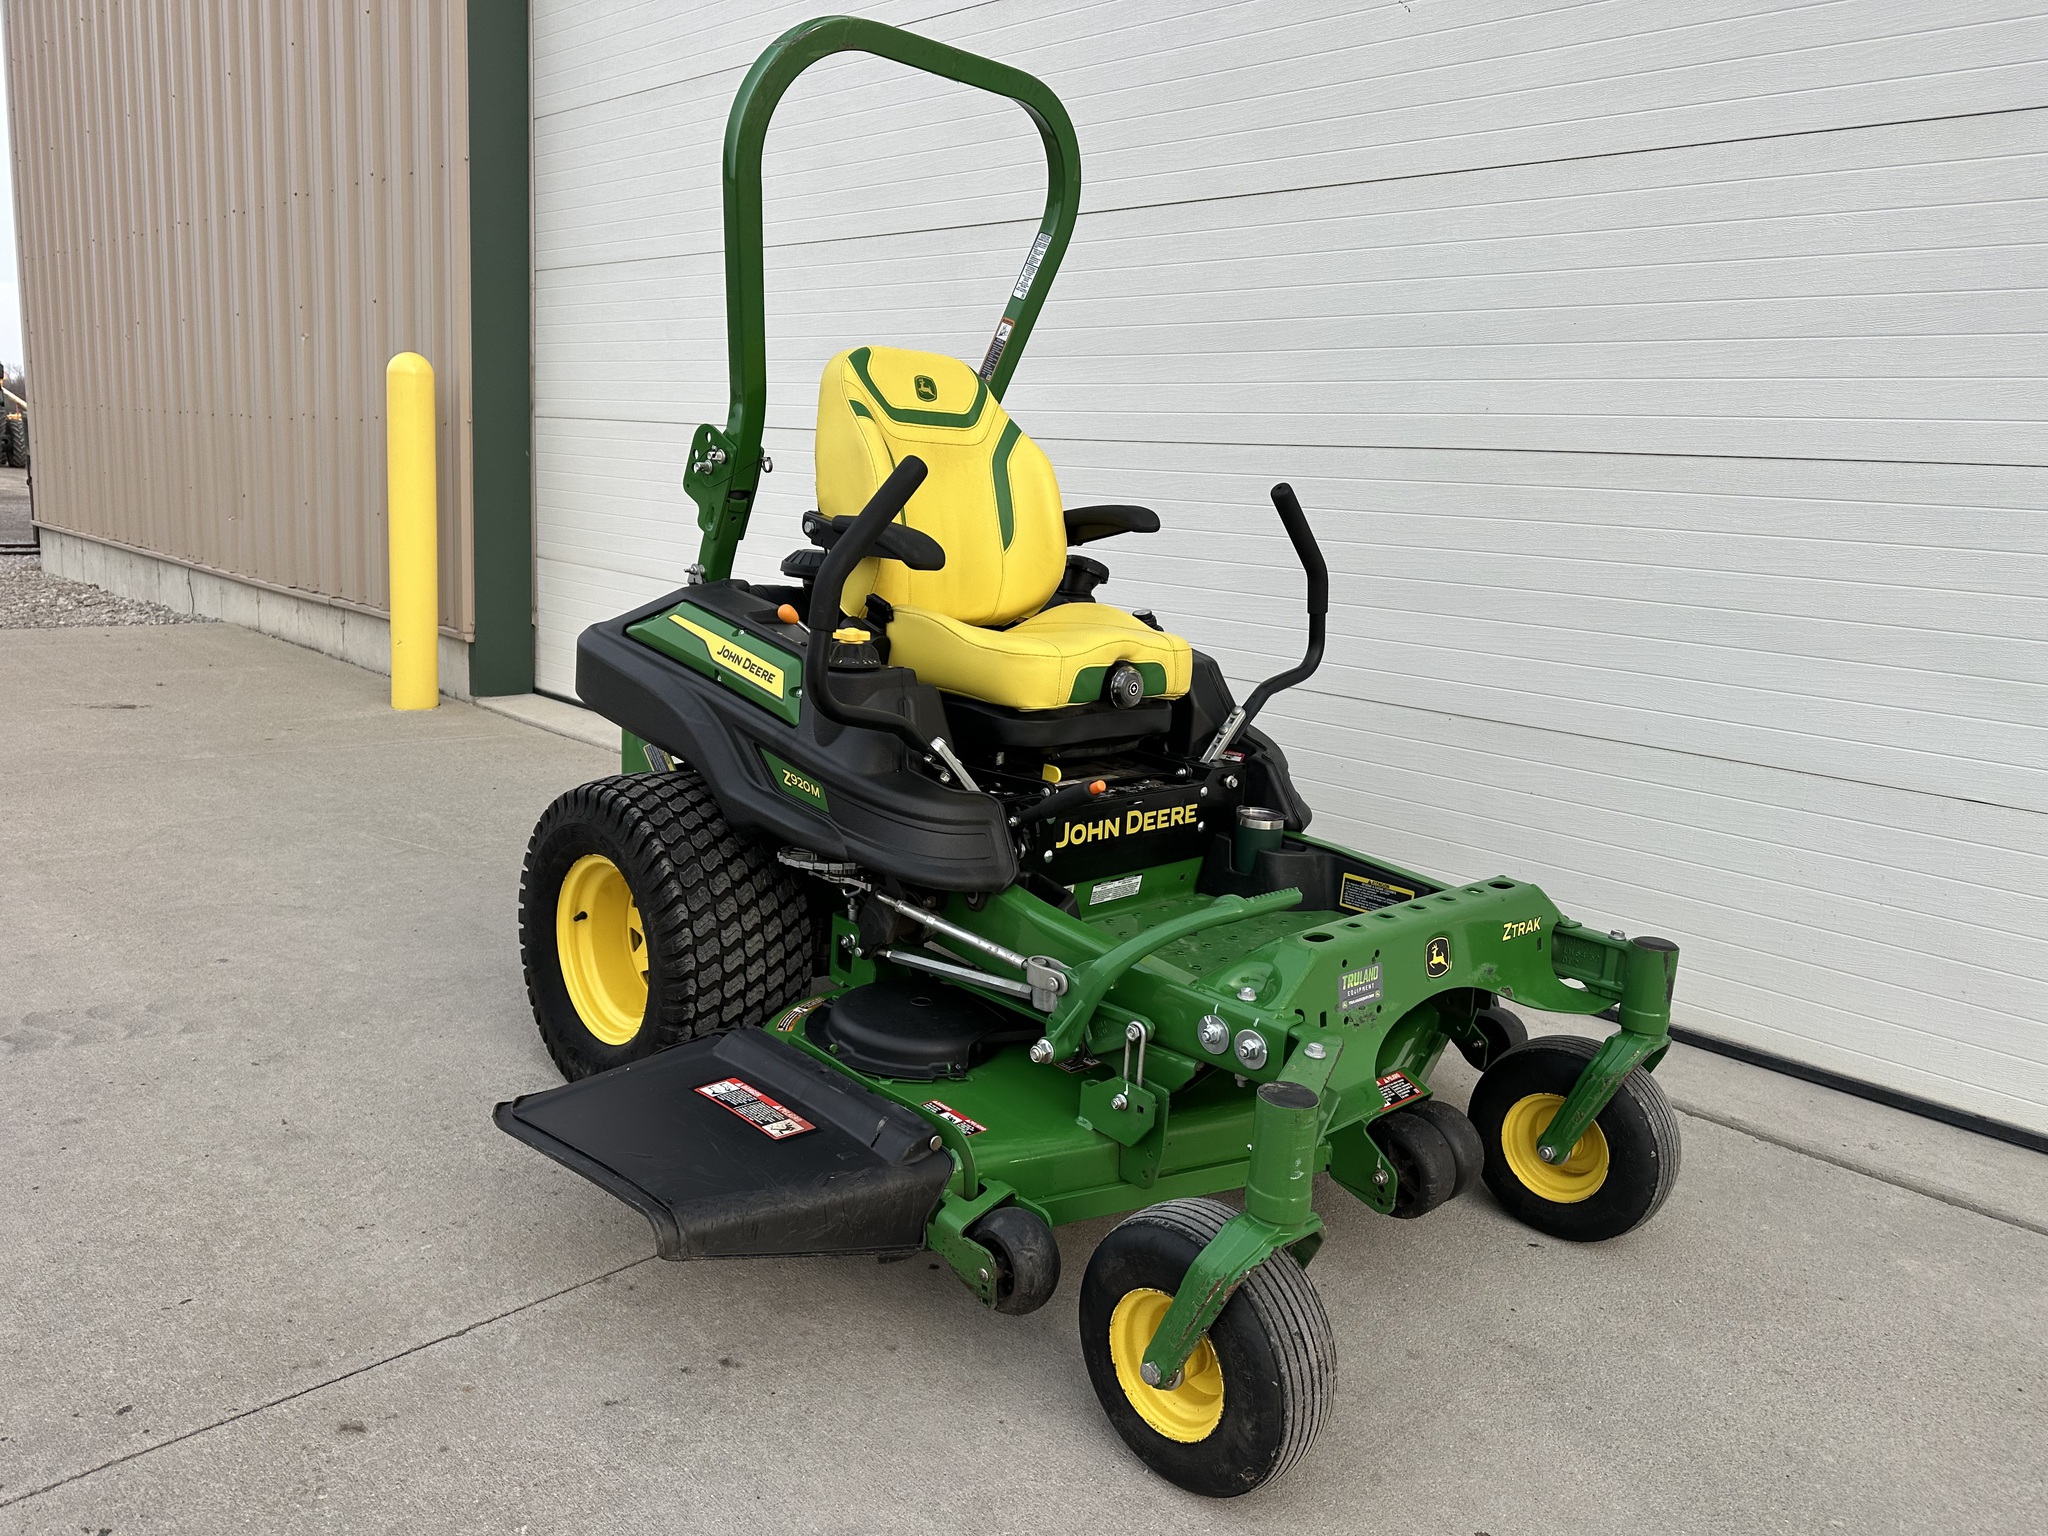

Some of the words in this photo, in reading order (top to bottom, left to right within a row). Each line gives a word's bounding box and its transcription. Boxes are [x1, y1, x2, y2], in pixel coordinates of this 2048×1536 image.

[717, 645, 743, 666] JOHN
[742, 658, 776, 684] DEERE
[782, 768, 821, 799] Z920M
[1055, 817, 1121, 849] JOHN
[1126, 804, 1198, 835] DEERE
[1502, 916, 1542, 942] ZTRAK
[1341, 965, 1379, 990] TRULAND
